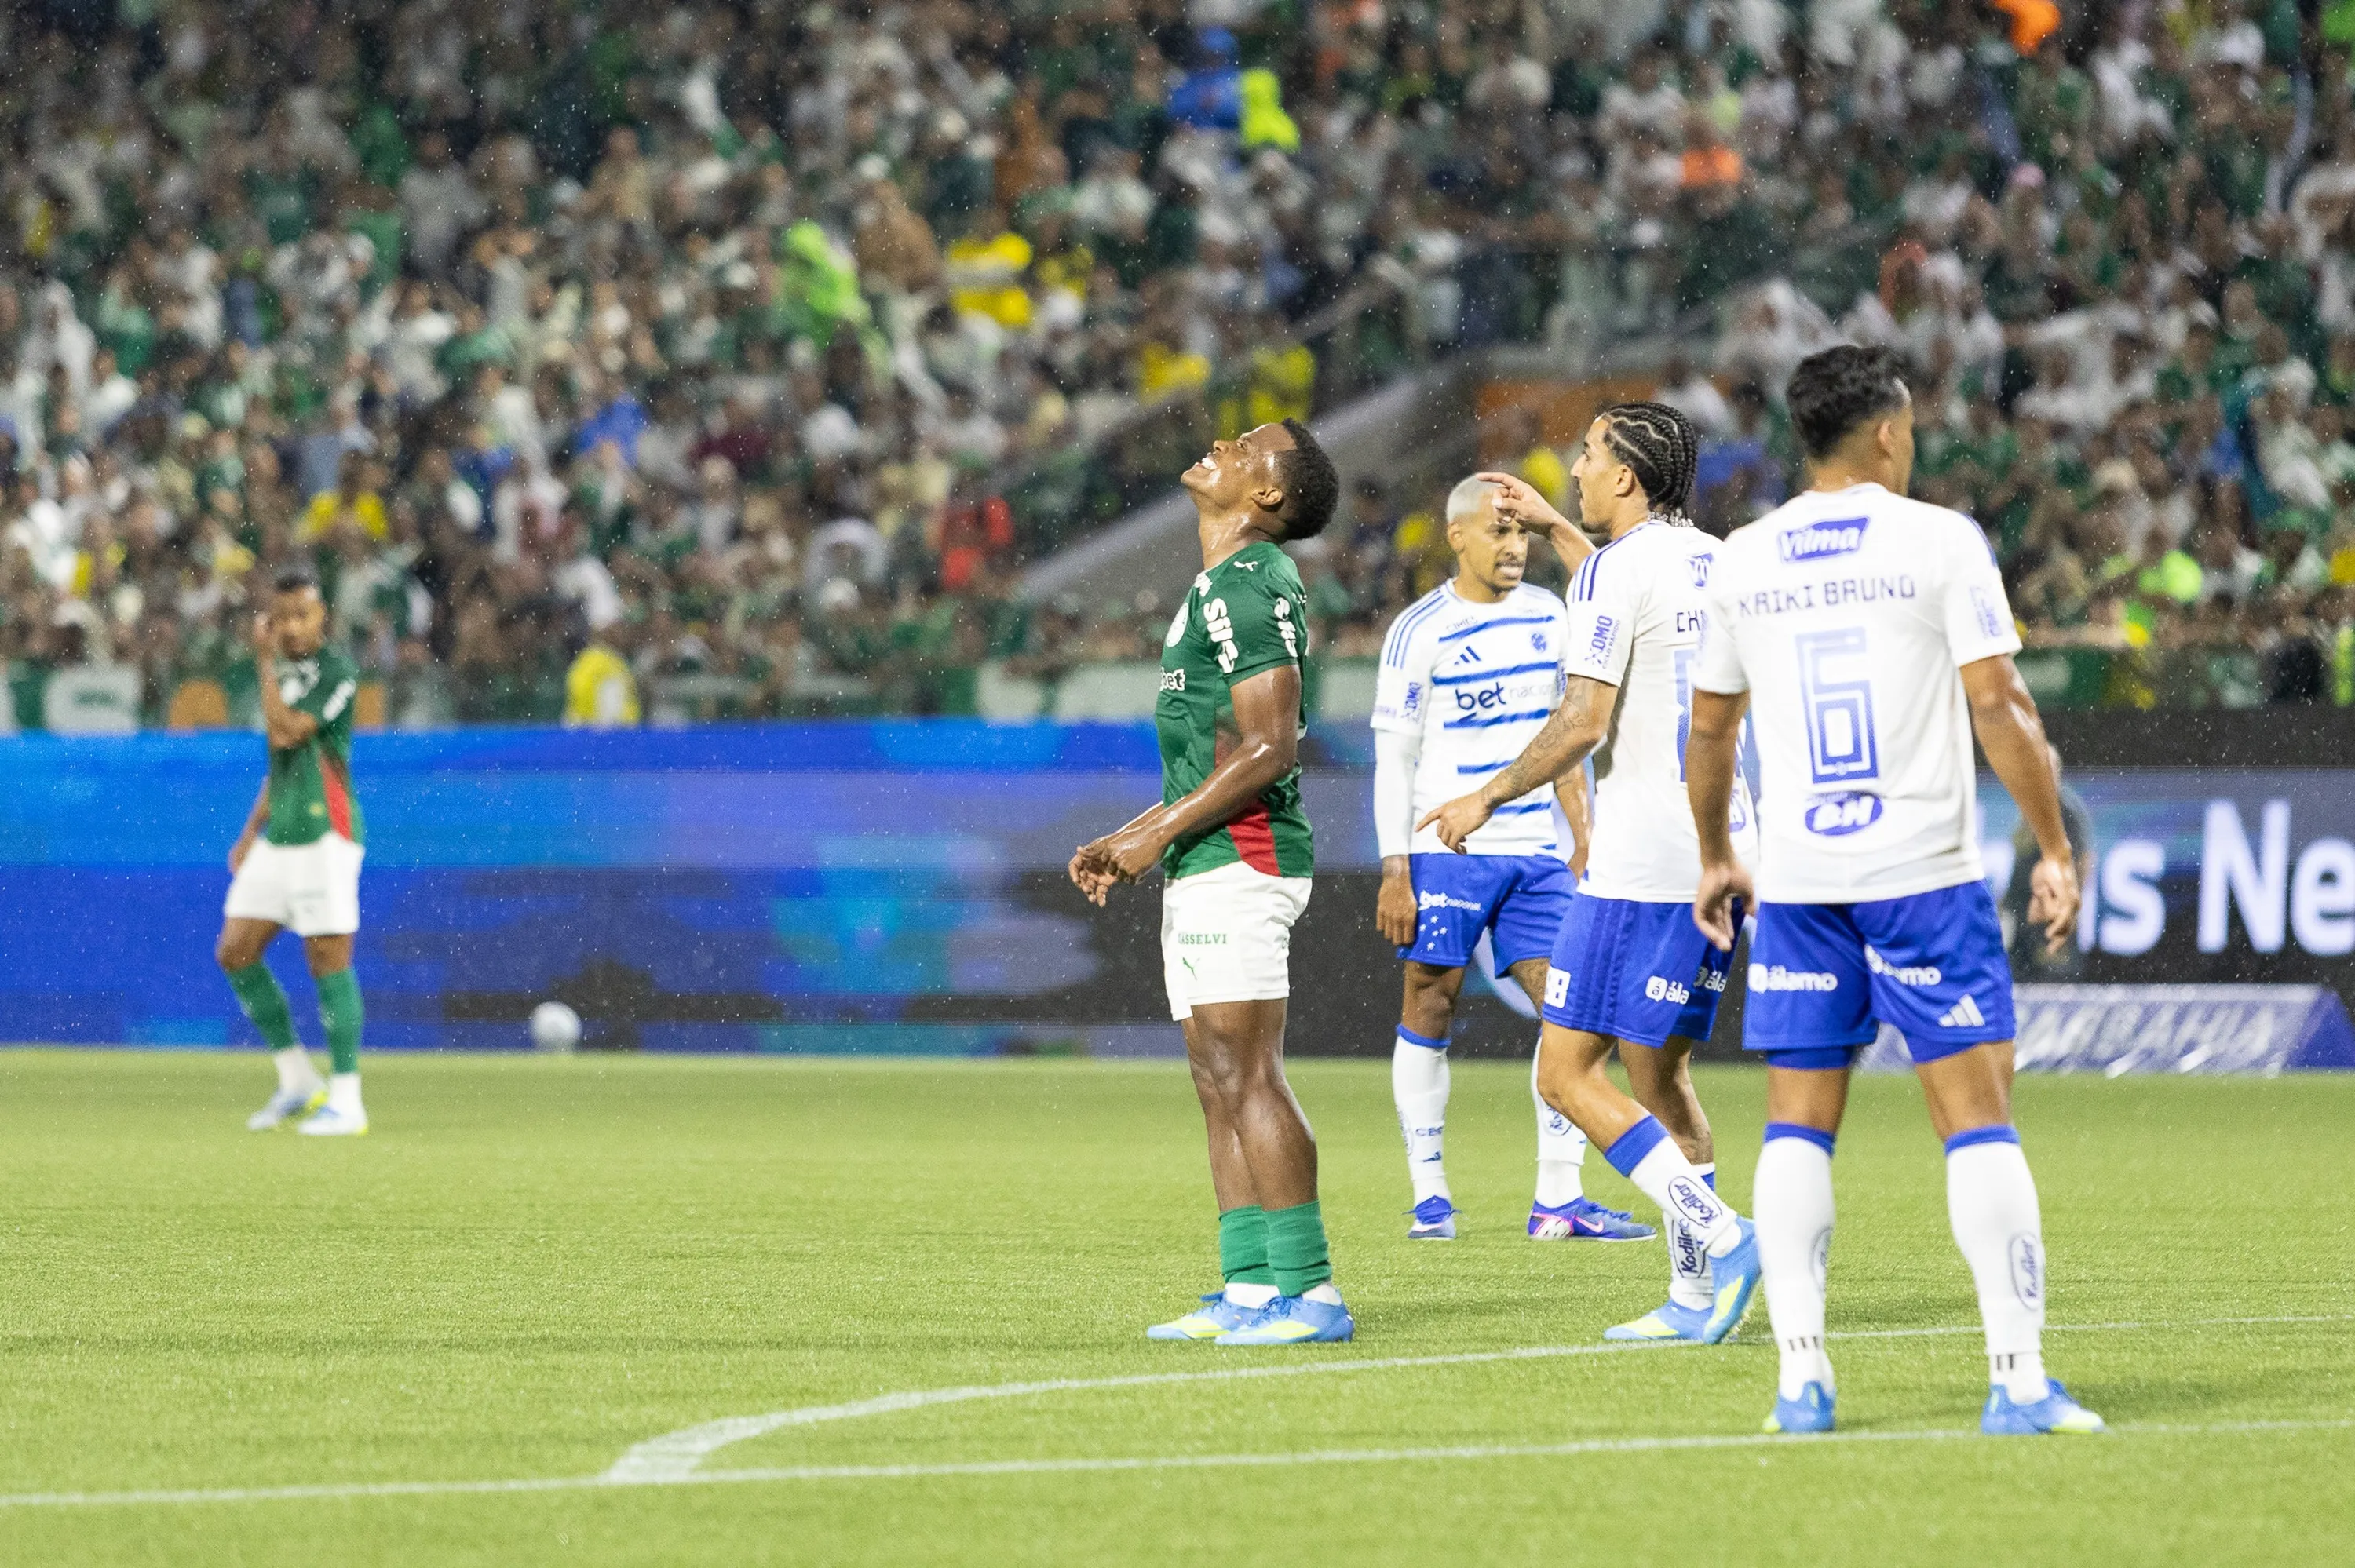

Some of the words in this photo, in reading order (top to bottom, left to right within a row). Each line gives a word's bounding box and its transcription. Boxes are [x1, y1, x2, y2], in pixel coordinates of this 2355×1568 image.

[1780, 527, 1860, 560] Vilma
[1591, 615, 1613, 651] OMO
[1677, 610, 1705, 633] CH
[1795, 626, 1879, 784] 6
[1767, 957, 1838, 992] álamo
[1674, 1183, 1719, 1224] Kodilar
